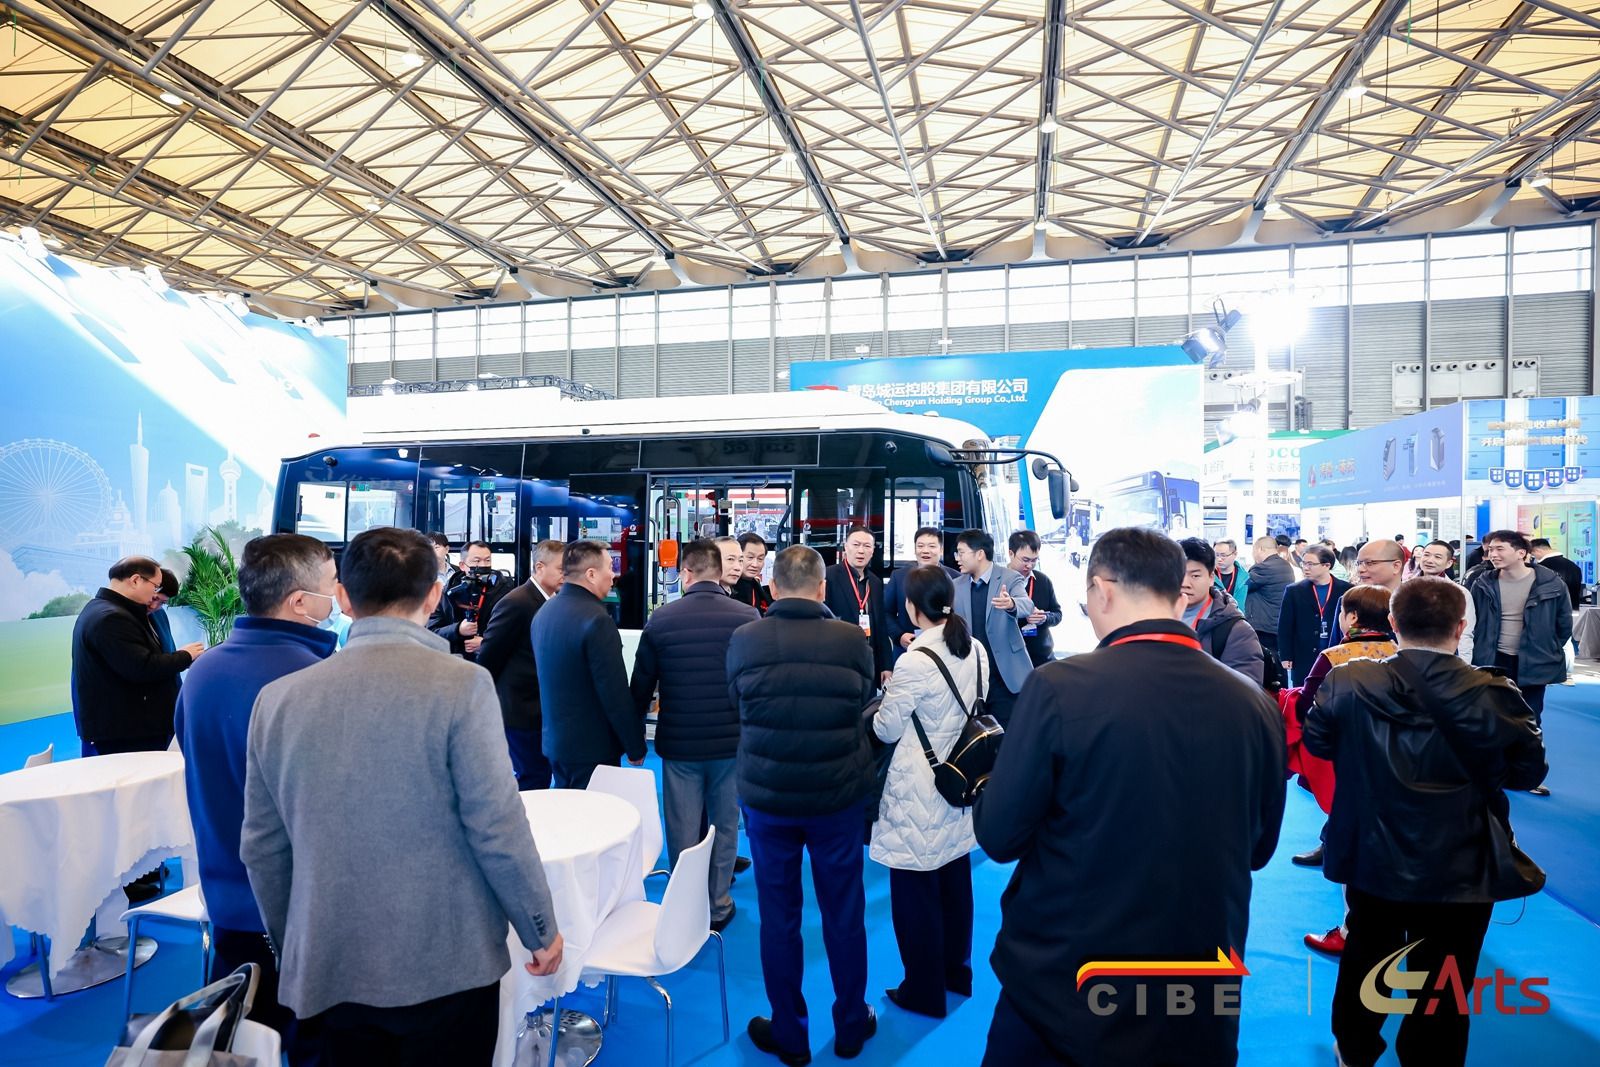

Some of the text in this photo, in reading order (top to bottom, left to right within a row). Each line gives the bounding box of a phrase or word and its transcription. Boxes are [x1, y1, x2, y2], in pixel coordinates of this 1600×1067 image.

[884, 397, 926, 407] Chengyun
[928, 396, 962, 406] Holding
[965, 395, 992, 405] Group
